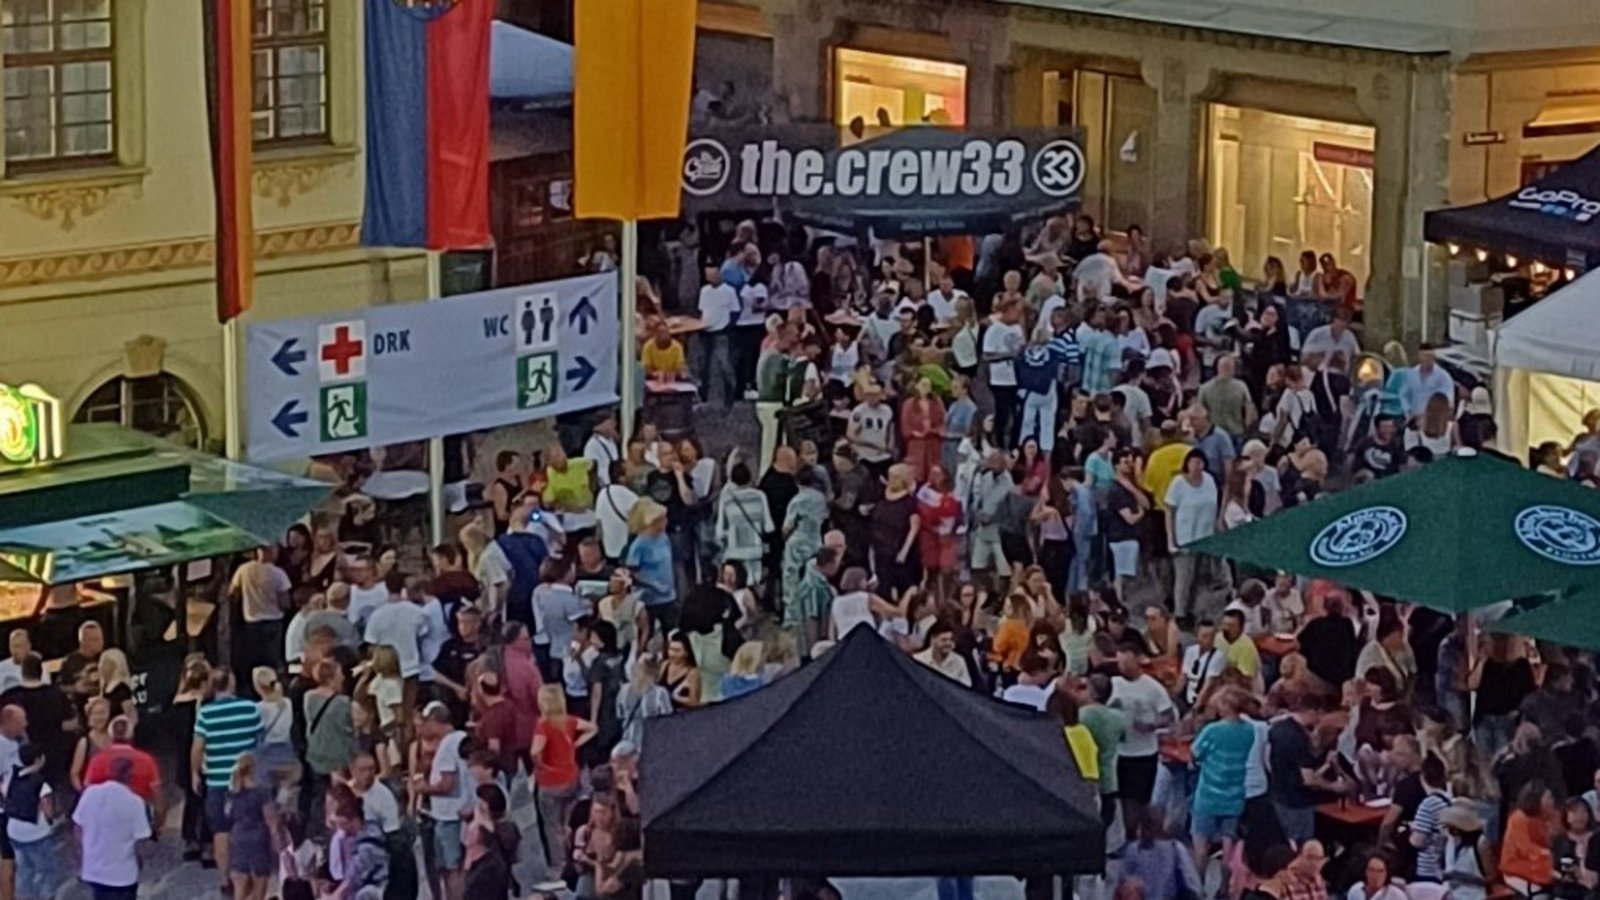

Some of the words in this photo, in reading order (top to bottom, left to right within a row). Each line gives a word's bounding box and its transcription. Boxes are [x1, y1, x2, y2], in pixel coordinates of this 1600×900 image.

[741, 140, 1025, 196] the.crew33
[1518, 186, 1600, 215] GoPro
[483, 314, 509, 339] WC
[373, 329, 411, 355] DRK
